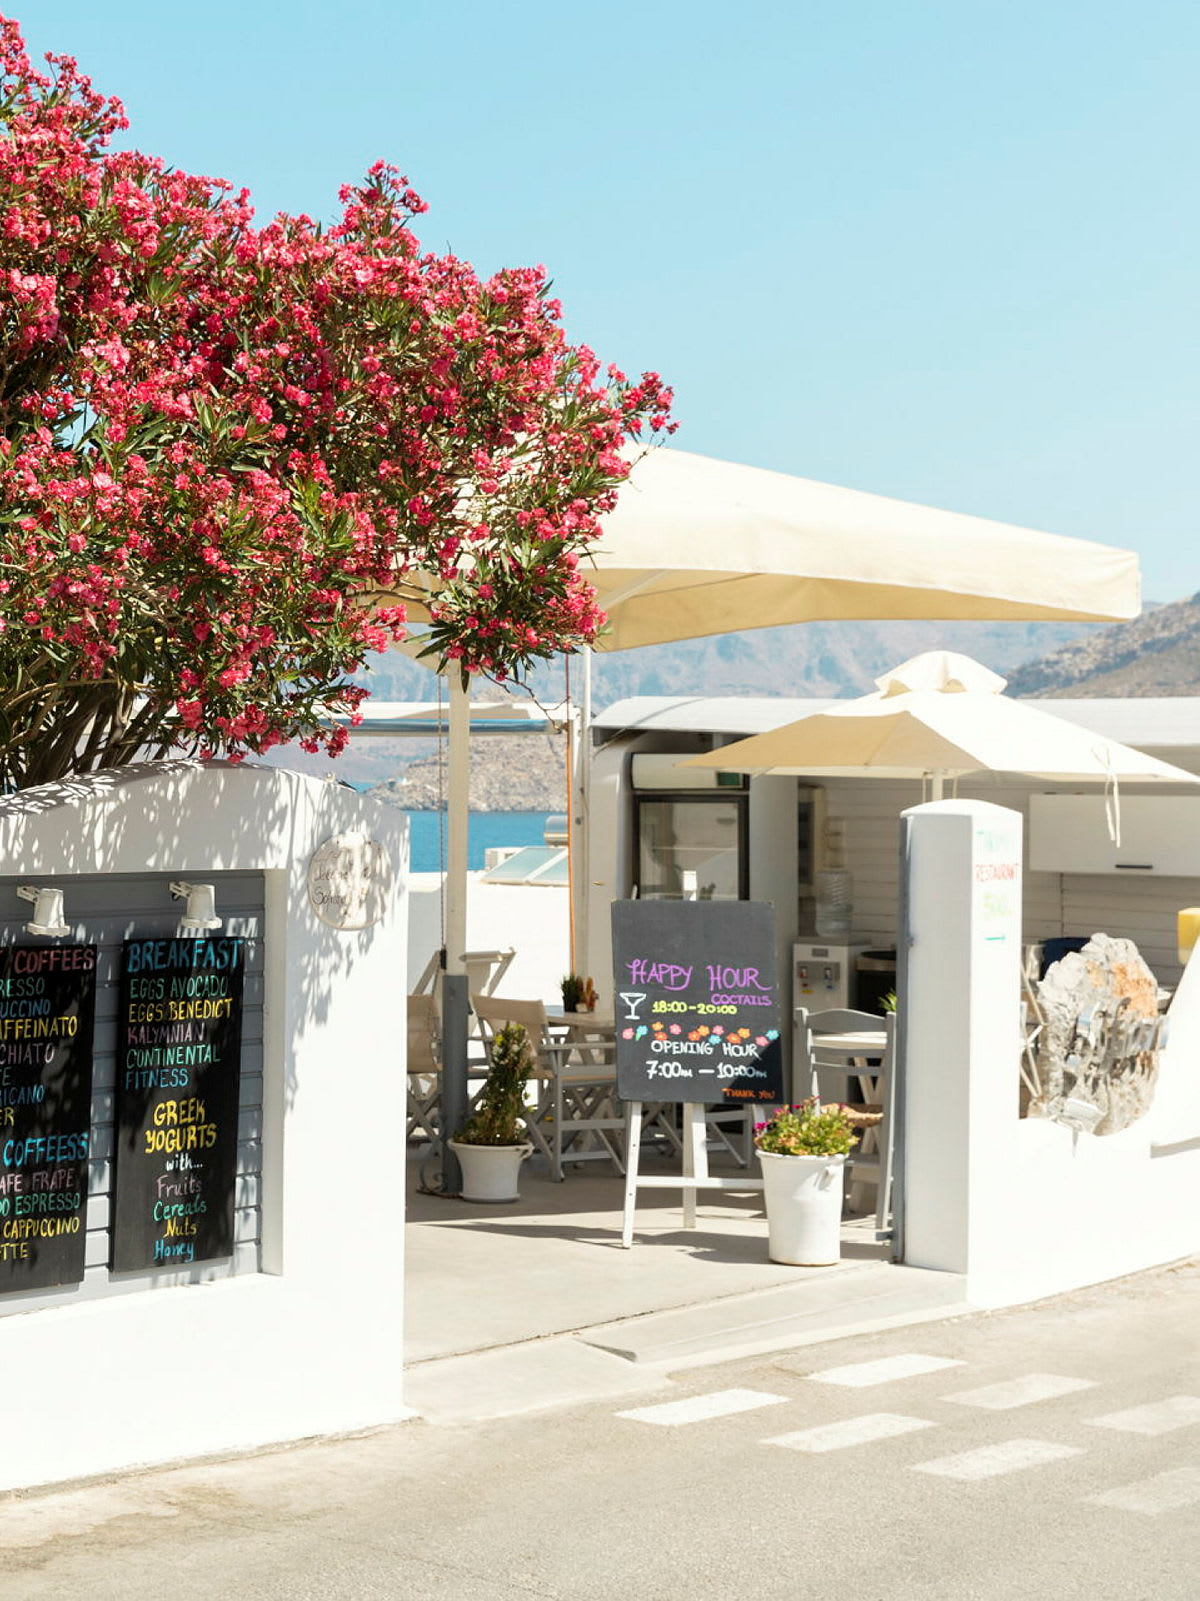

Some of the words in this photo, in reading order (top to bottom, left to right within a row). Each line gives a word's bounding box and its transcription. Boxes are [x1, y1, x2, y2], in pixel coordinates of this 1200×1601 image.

[13, 949, 95, 974] COFFEES
[127, 939, 244, 973] BREAKFAST
[130, 977, 165, 1000] EGGS
[170, 974, 229, 999] AVOCADO
[626, 958, 694, 991] HAPPY
[706, 964, 773, 991] HOUR
[129, 1002, 164, 1023] EGGS
[168, 998, 233, 1021] BENEDICT
[710, 993, 773, 1006] COCTAILS
[127, 1022, 205, 1045] KALYMNIAN
[126, 1044, 221, 1069] CONTINENTAL
[650, 1040, 714, 1056] OPENING
[722, 1042, 762, 1061] HOUR
[125, 1067, 189, 1090] FITNESS
[153, 1097, 206, 1126] GREEK
[145, 1122, 217, 1154] YOGURTS
[32, 1168, 76, 1191] FRAPE
[156, 1174, 202, 1199] Fruits
[15, 1192, 81, 1215] ESPRESSO
[153, 1194, 208, 1221] Cereals
[3, 1216, 81, 1240] CAPPUCCINO
[163, 1216, 198, 1239] Nuts
[153, 1239, 195, 1263] Honey
